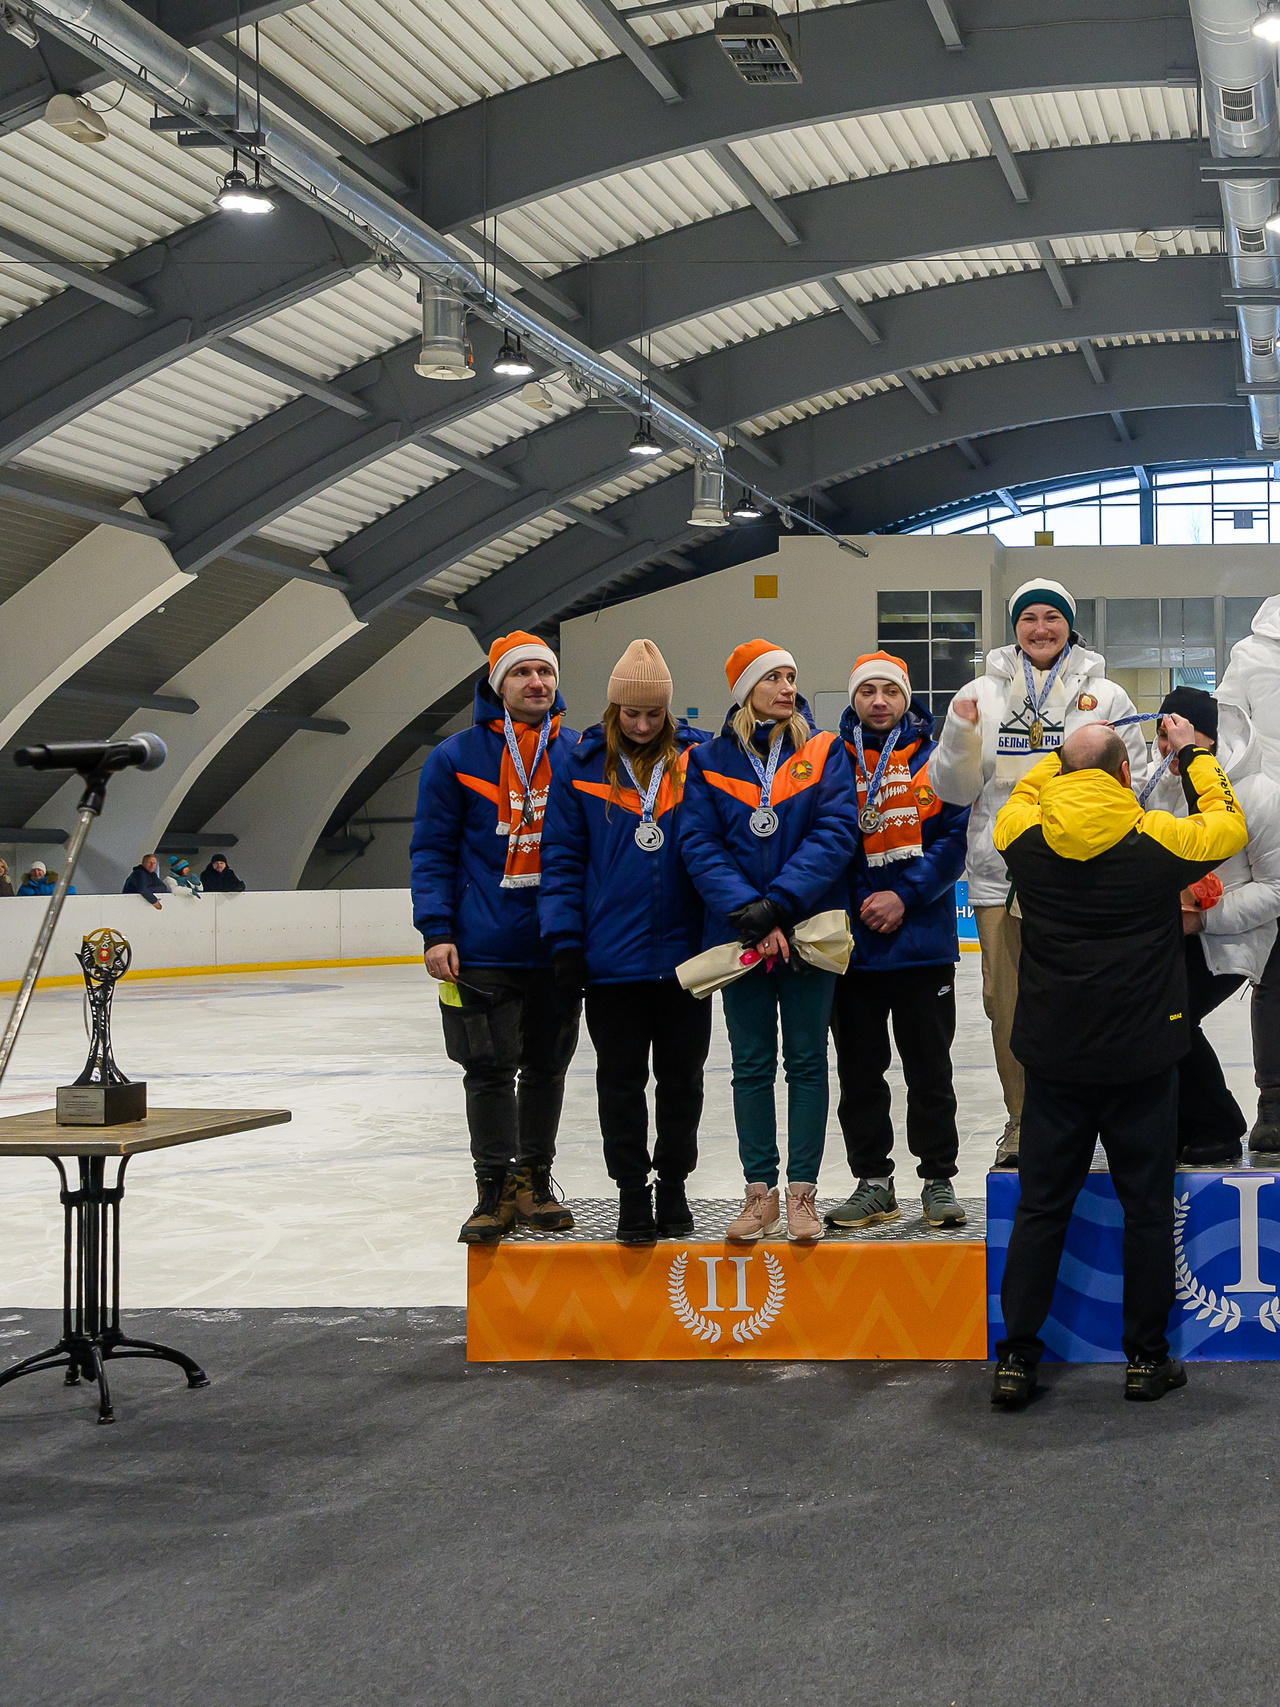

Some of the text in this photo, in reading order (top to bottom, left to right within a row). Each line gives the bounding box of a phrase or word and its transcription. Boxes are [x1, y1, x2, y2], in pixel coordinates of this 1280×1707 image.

[998, 736, 1029, 748] БЕЛЫЕ
[1222, 1176, 1277, 1293] I
[698, 1256, 755, 1312] II
